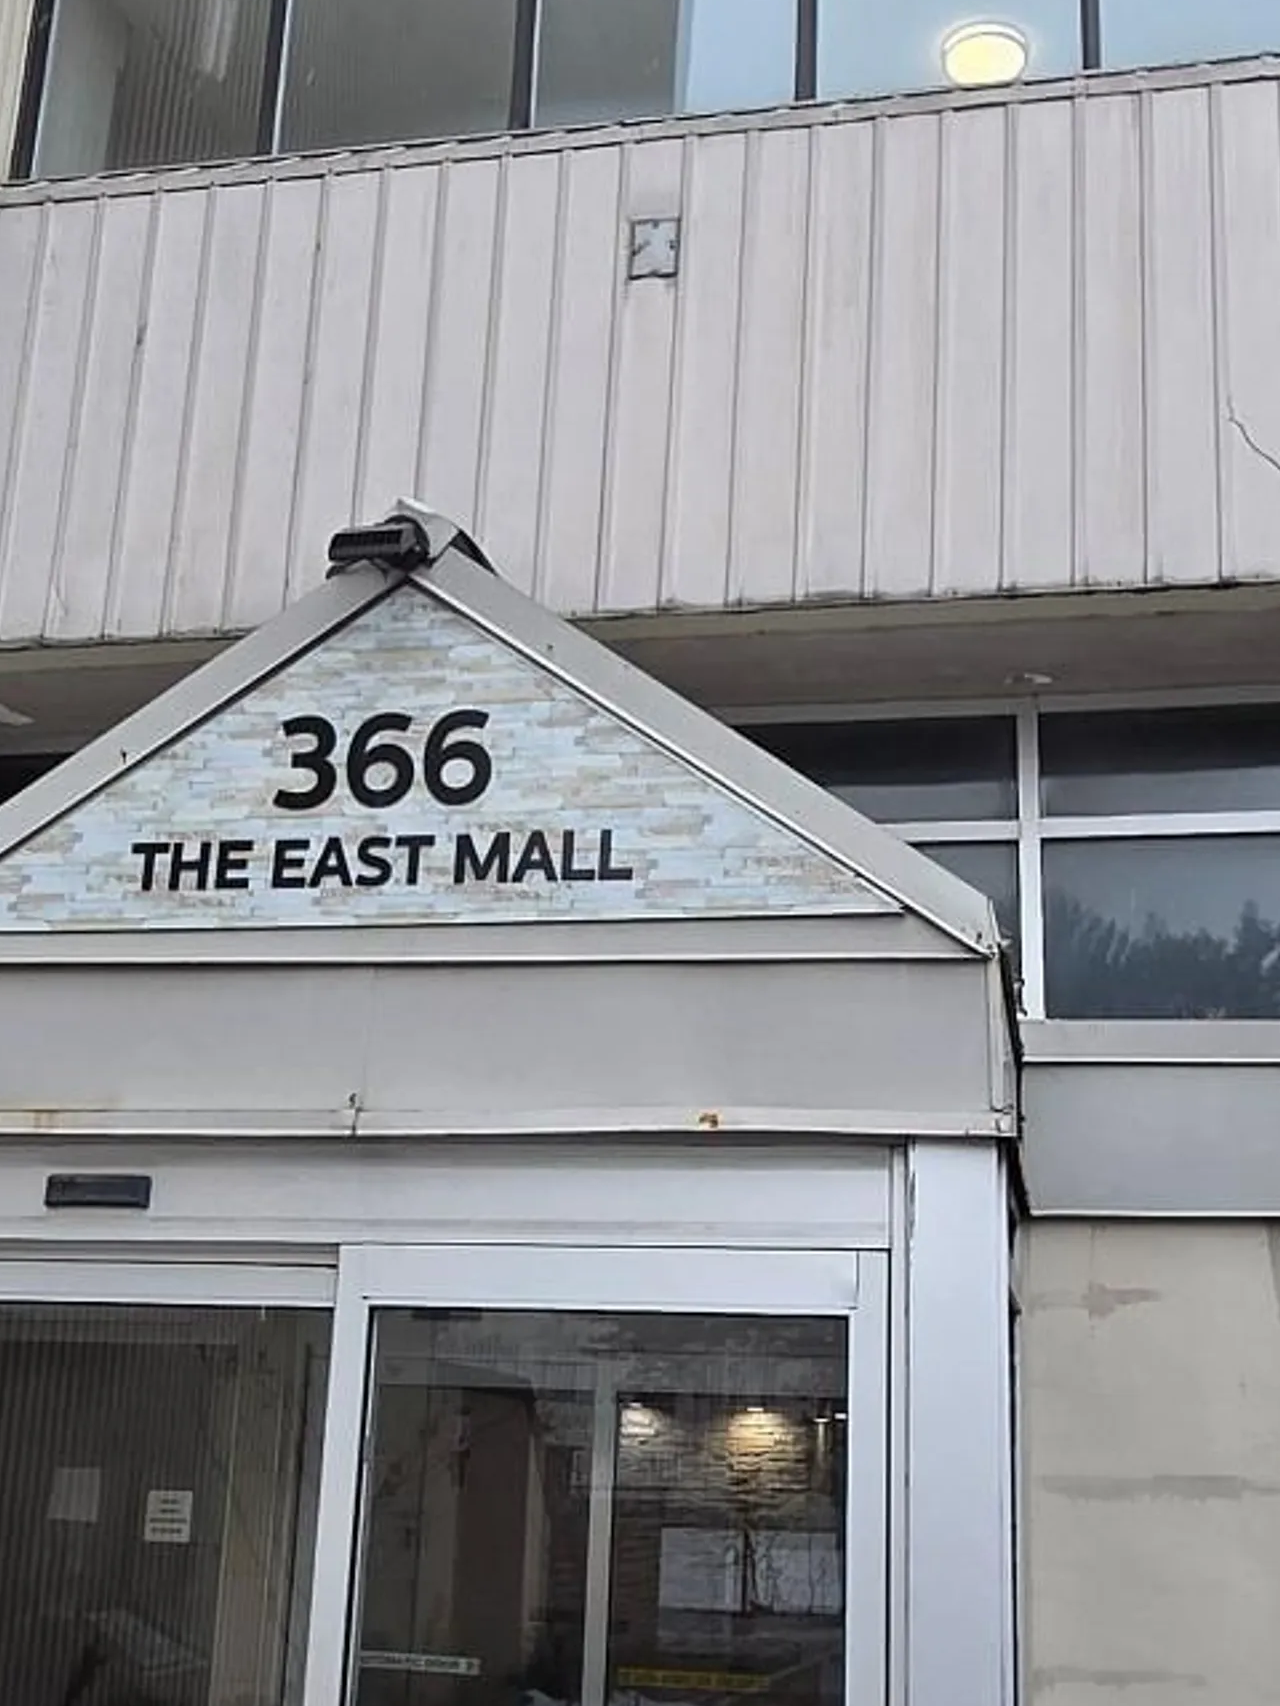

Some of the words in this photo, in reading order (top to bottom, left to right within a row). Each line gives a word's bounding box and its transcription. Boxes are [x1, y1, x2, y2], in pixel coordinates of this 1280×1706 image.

[272, 709, 492, 810] 366
[131, 840, 254, 891] THE
[271, 834, 435, 889] EAST
[453, 829, 633, 884] MALL
